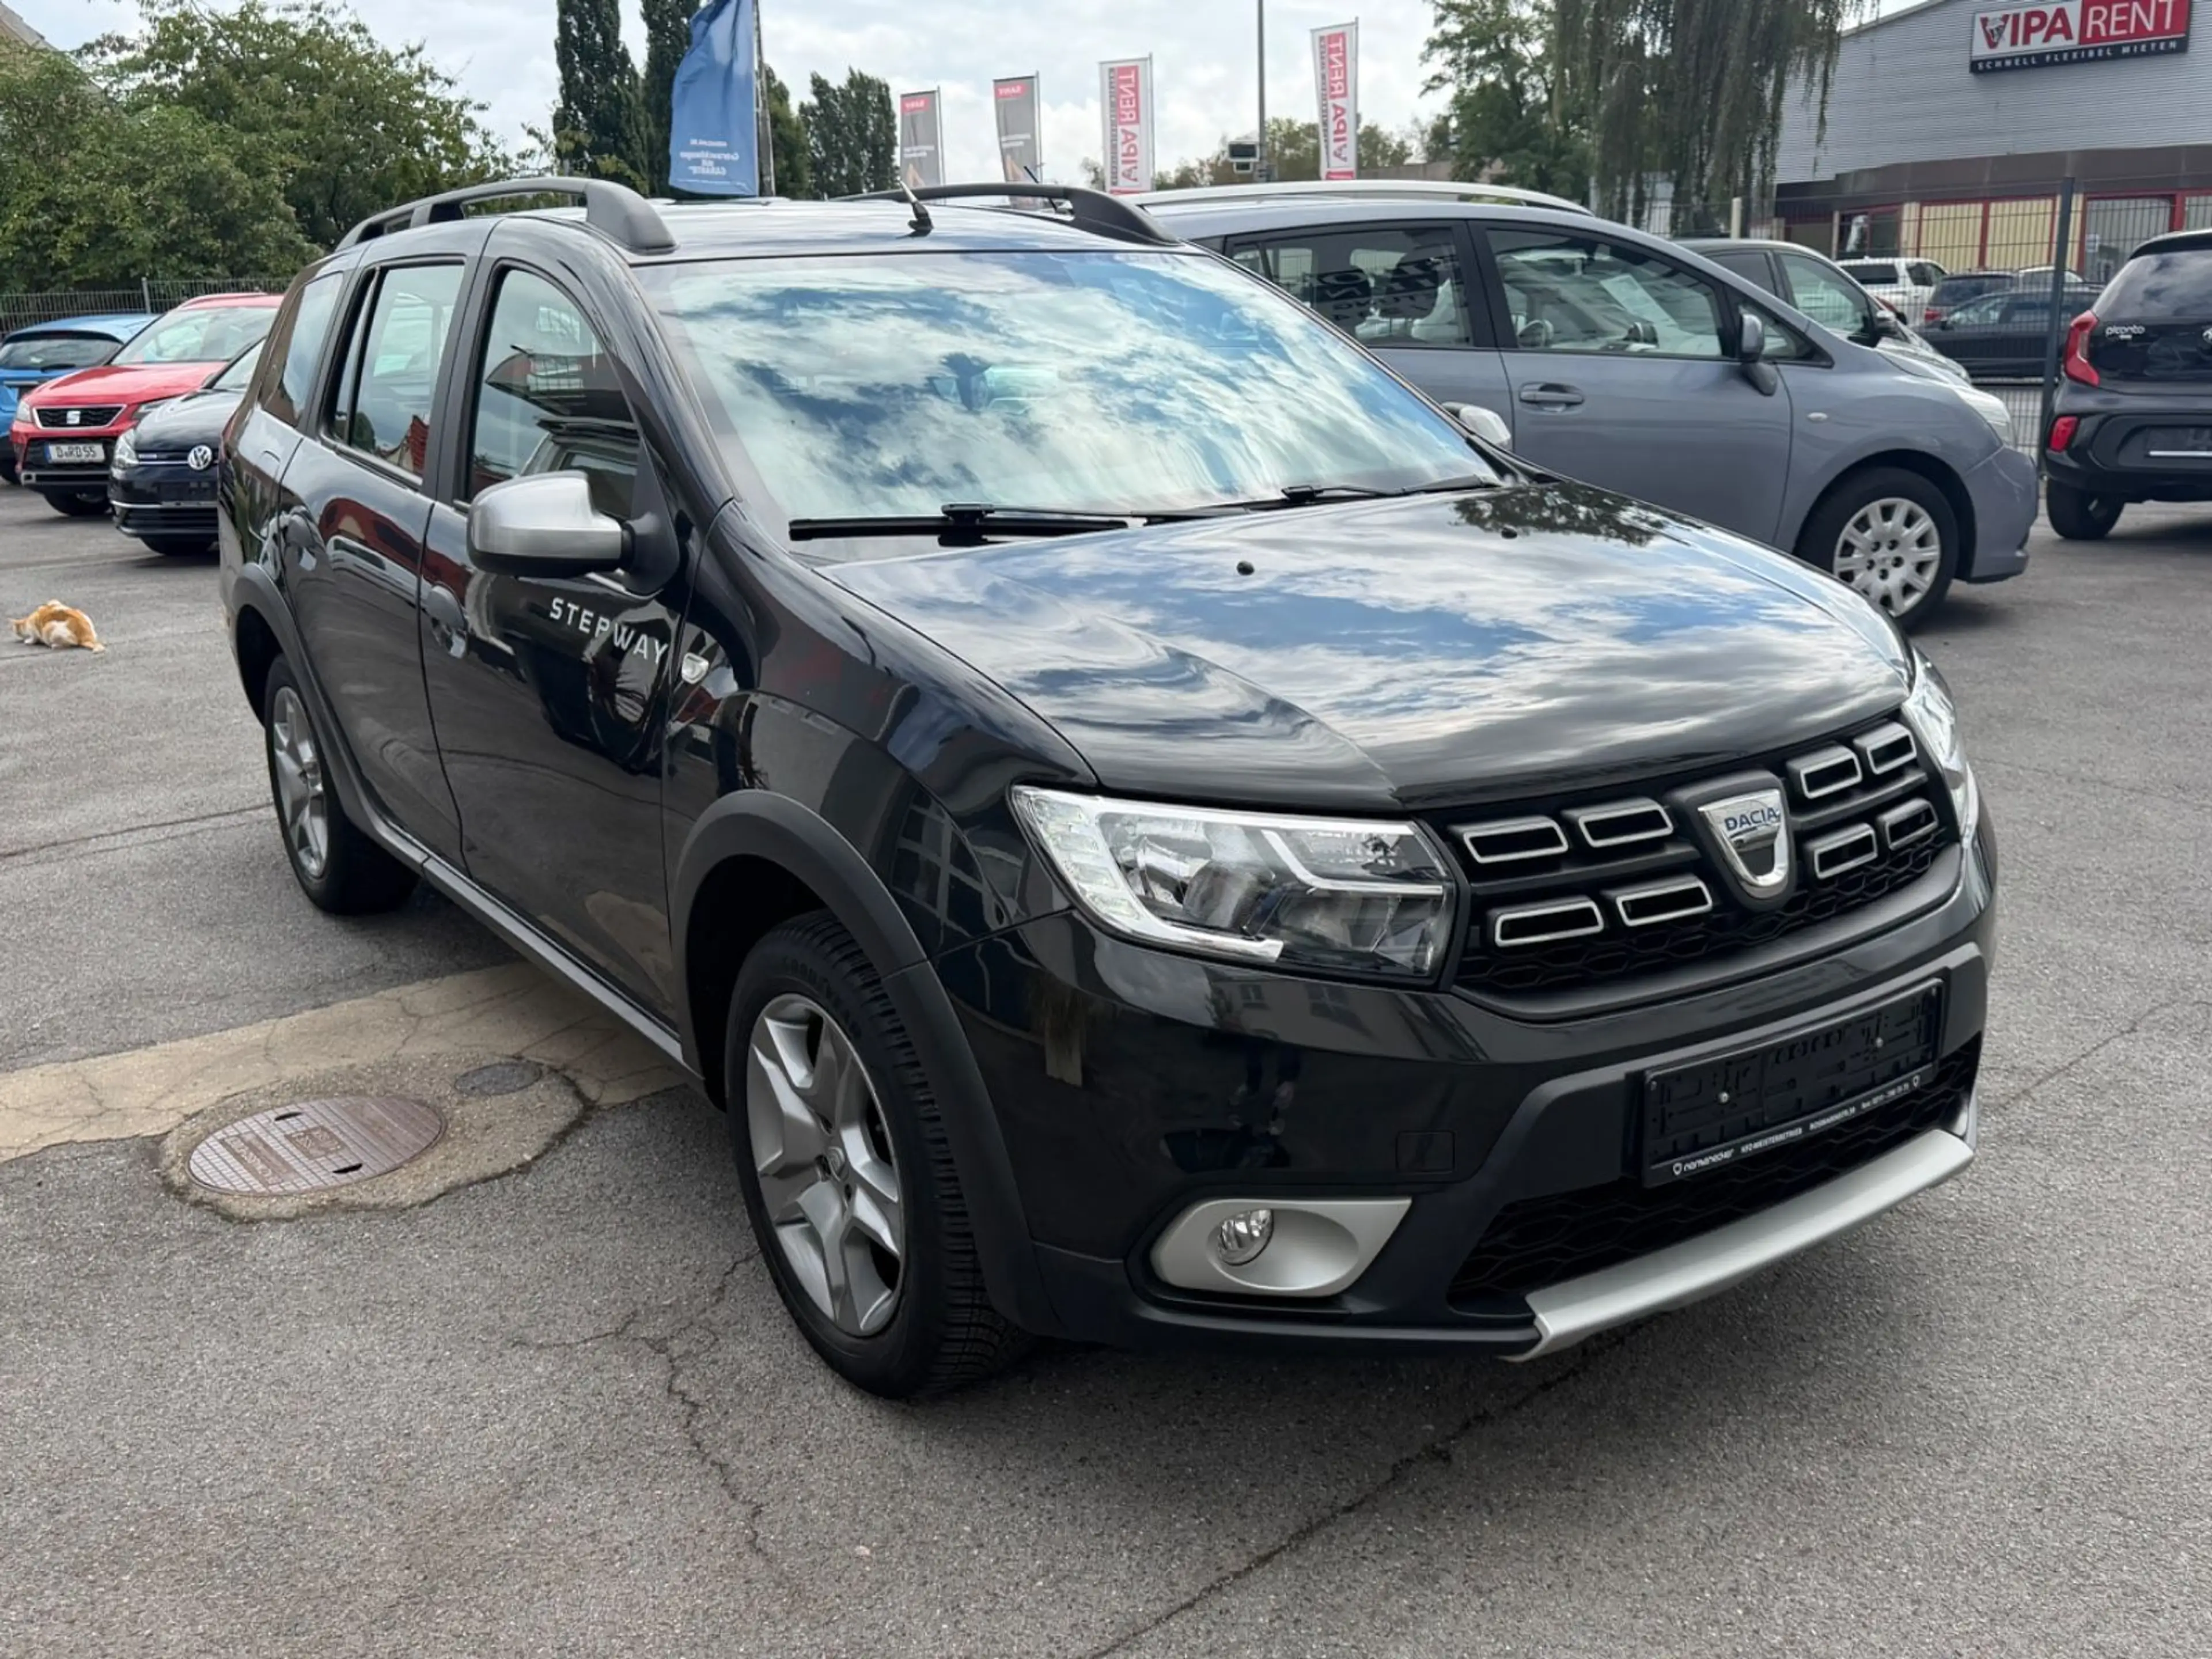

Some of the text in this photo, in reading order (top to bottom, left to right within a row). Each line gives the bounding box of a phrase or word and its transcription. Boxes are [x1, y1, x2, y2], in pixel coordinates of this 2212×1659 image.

[1980, 0, 2177, 50] VIPA RENT
[1977, 42, 2177, 70] SCHNELL FLEXIBEL MIETEN
[550, 597, 668, 665] STEPWAY
[1724, 807, 1781, 831] DACIA
